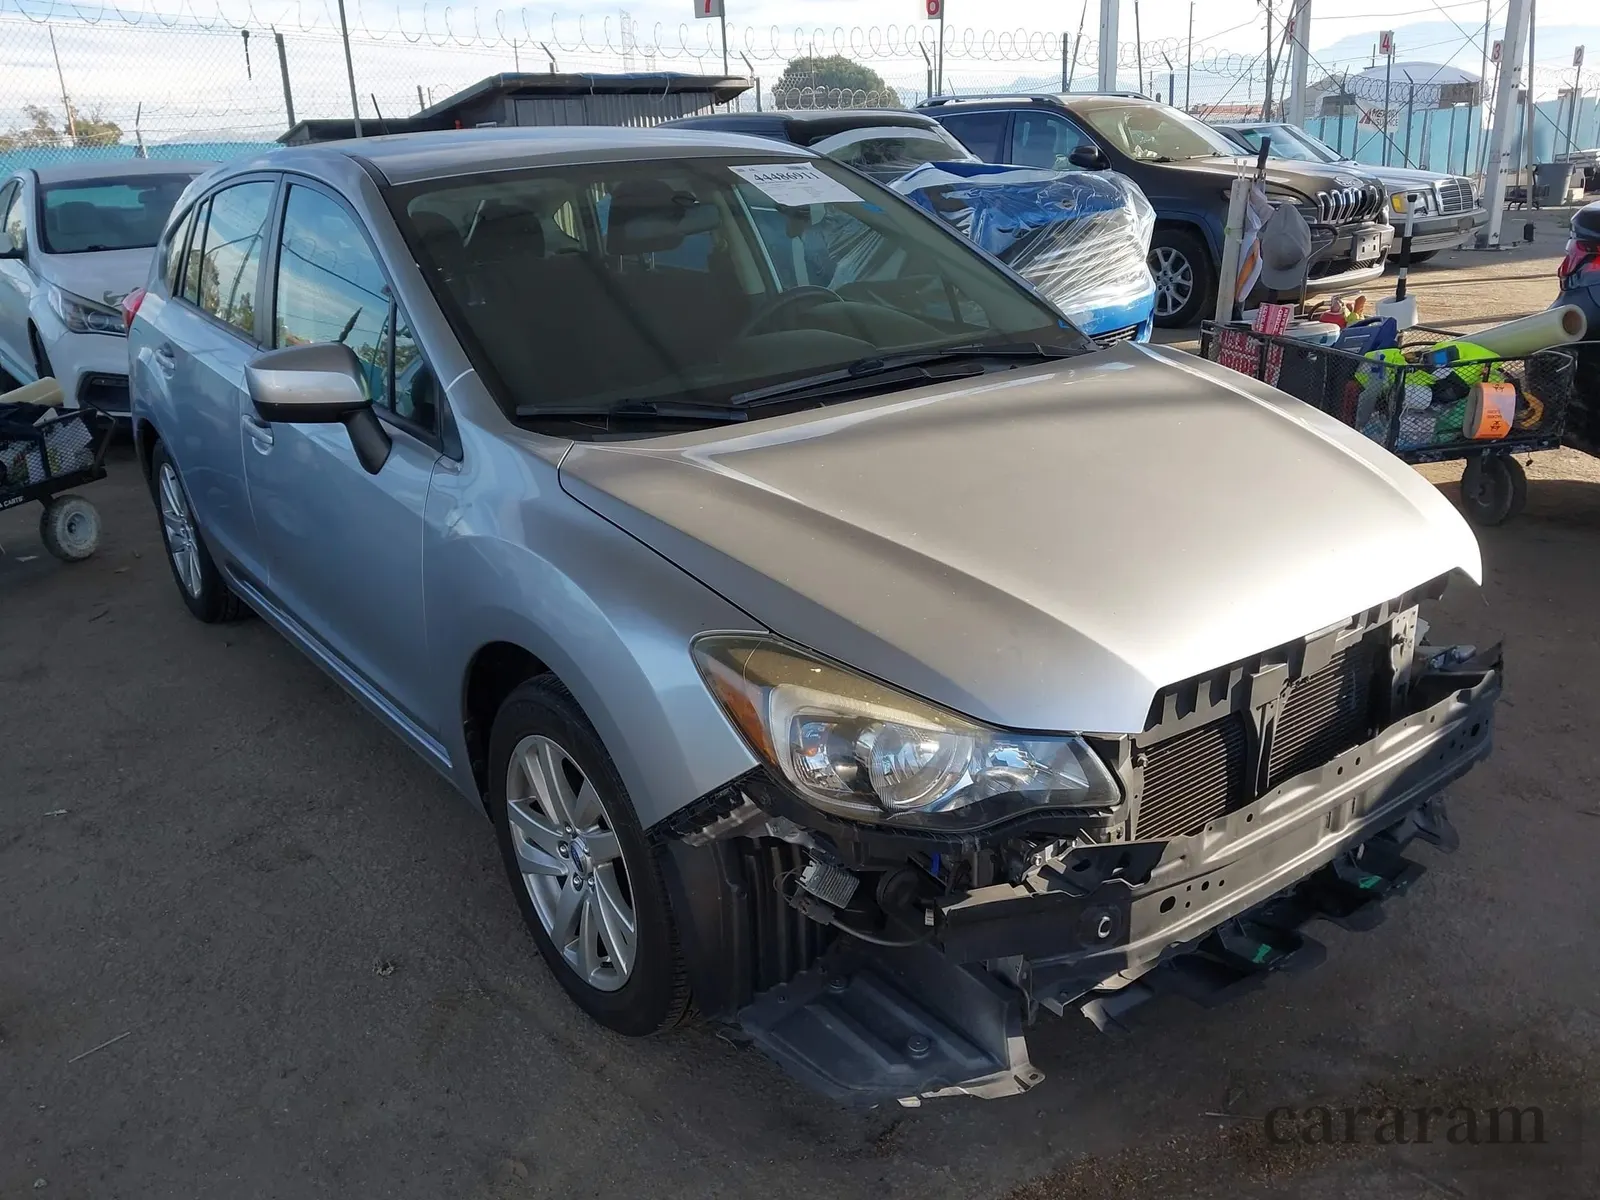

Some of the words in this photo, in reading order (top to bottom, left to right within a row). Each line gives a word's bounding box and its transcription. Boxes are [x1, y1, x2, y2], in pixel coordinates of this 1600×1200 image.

[1382, 33, 1391, 52] 4
[1494, 43, 1501, 60] 3
[1575, 48, 1582, 64] 2
